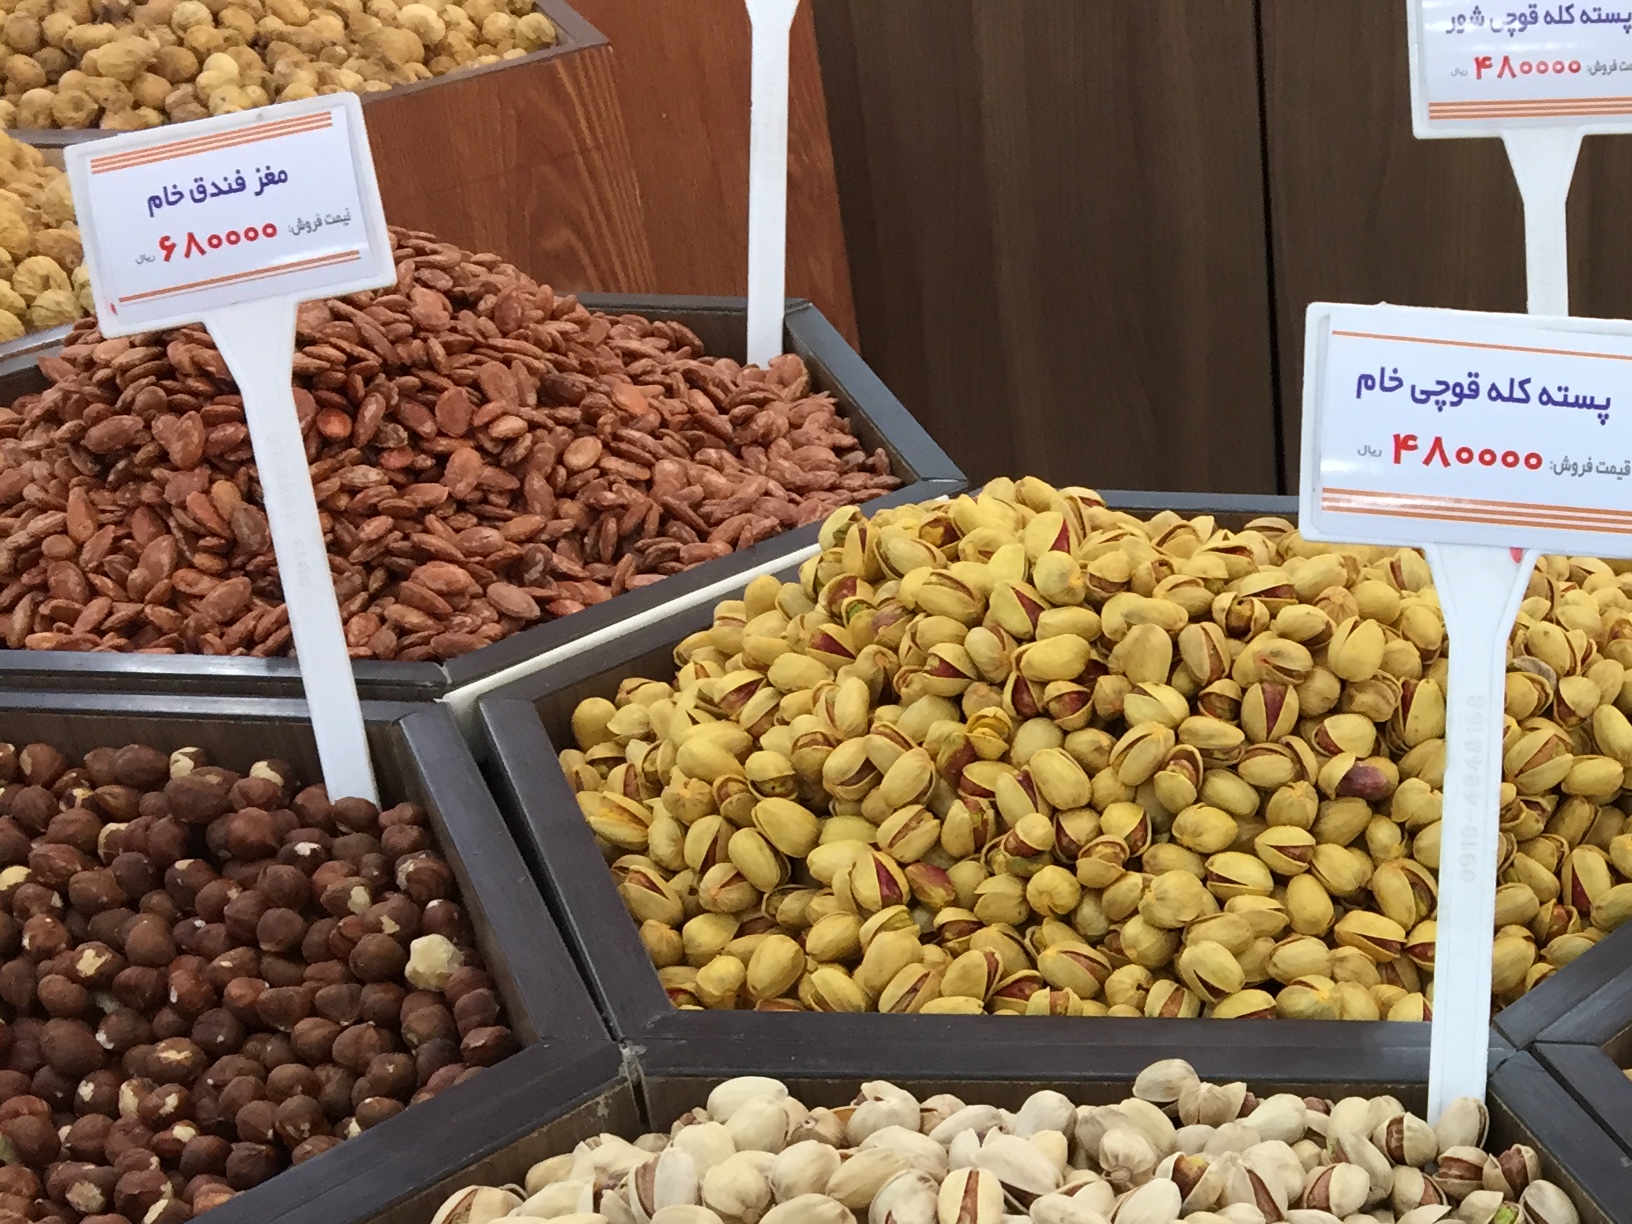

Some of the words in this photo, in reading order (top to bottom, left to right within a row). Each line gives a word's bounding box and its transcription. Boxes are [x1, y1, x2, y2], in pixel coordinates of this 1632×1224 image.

[1446, 6, 1484, 34] شور
[1490, 4, 1538, 37] قوچی
[1544, 3, 1574, 25] کله
[1580, 7, 1632, 34] پسته
[1475, 56, 1581, 80] ۴۸۰۰۰۰
[190, 169, 246, 203] فندق
[254, 166, 288, 196] مغز
[148, 184, 184, 217] خام
[325, 208, 351, 226] قیمت
[159, 223, 277, 262] ۶۸۰۰۰۰
[1356, 367, 1403, 399] خام
[1411, 372, 1480, 412] قوچی
[1487, 378, 1531, 404] کله
[1538, 386, 1611, 426] پسته
[1357, 445, 1382, 457] ریال
[1393, 434, 1542, 469] ۴۸۰۰۰۰
[1596, 460, 1630, 480] قیمت
